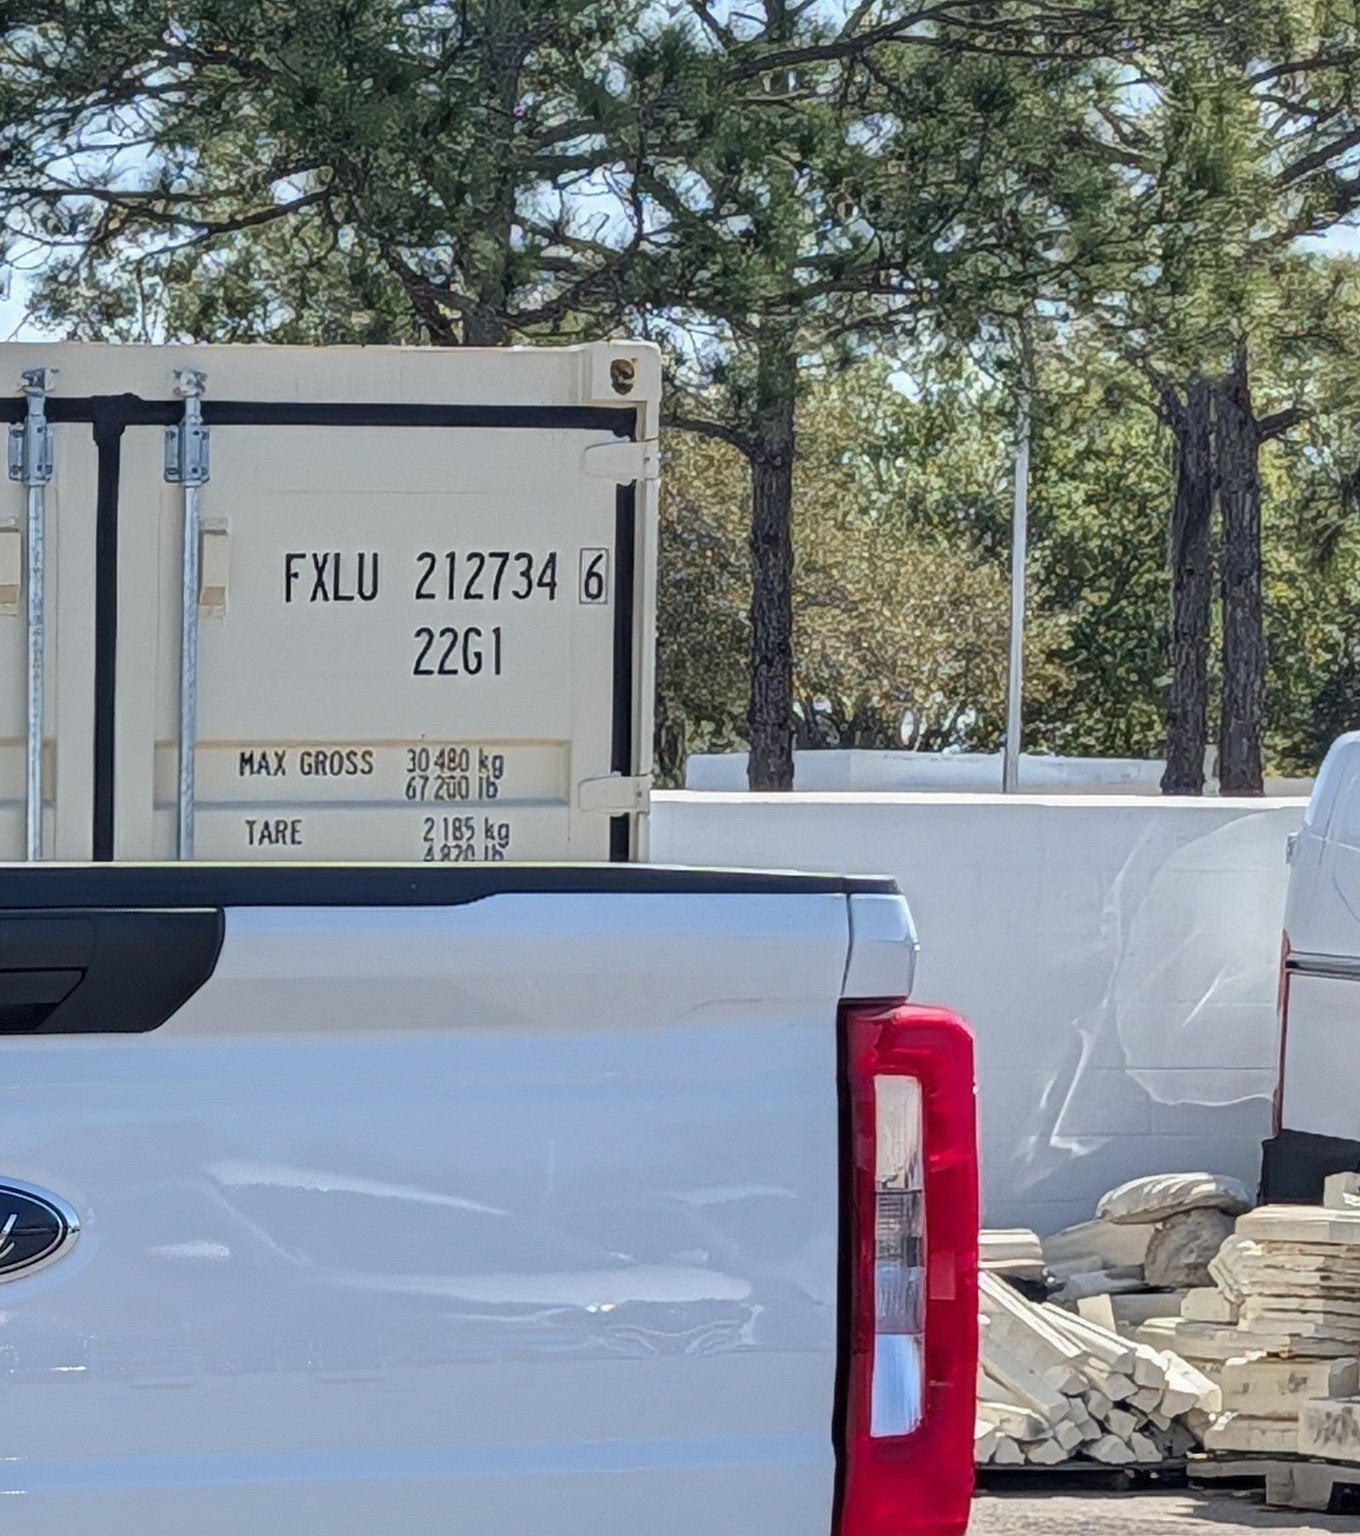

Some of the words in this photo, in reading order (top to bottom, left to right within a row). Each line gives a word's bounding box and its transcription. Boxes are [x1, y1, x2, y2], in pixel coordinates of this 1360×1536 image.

[284, 552, 379, 602] FXLU
[415, 551, 557, 600] 212734
[583, 552, 603, 600] 6
[413, 626, 501, 675] 22G1
[239, 751, 286, 776] MAX
[300, 751, 374, 776] GROSS
[478, 747, 504, 780] kg
[245, 819, 303, 845] TARE
[485, 817, 510, 849] kg
